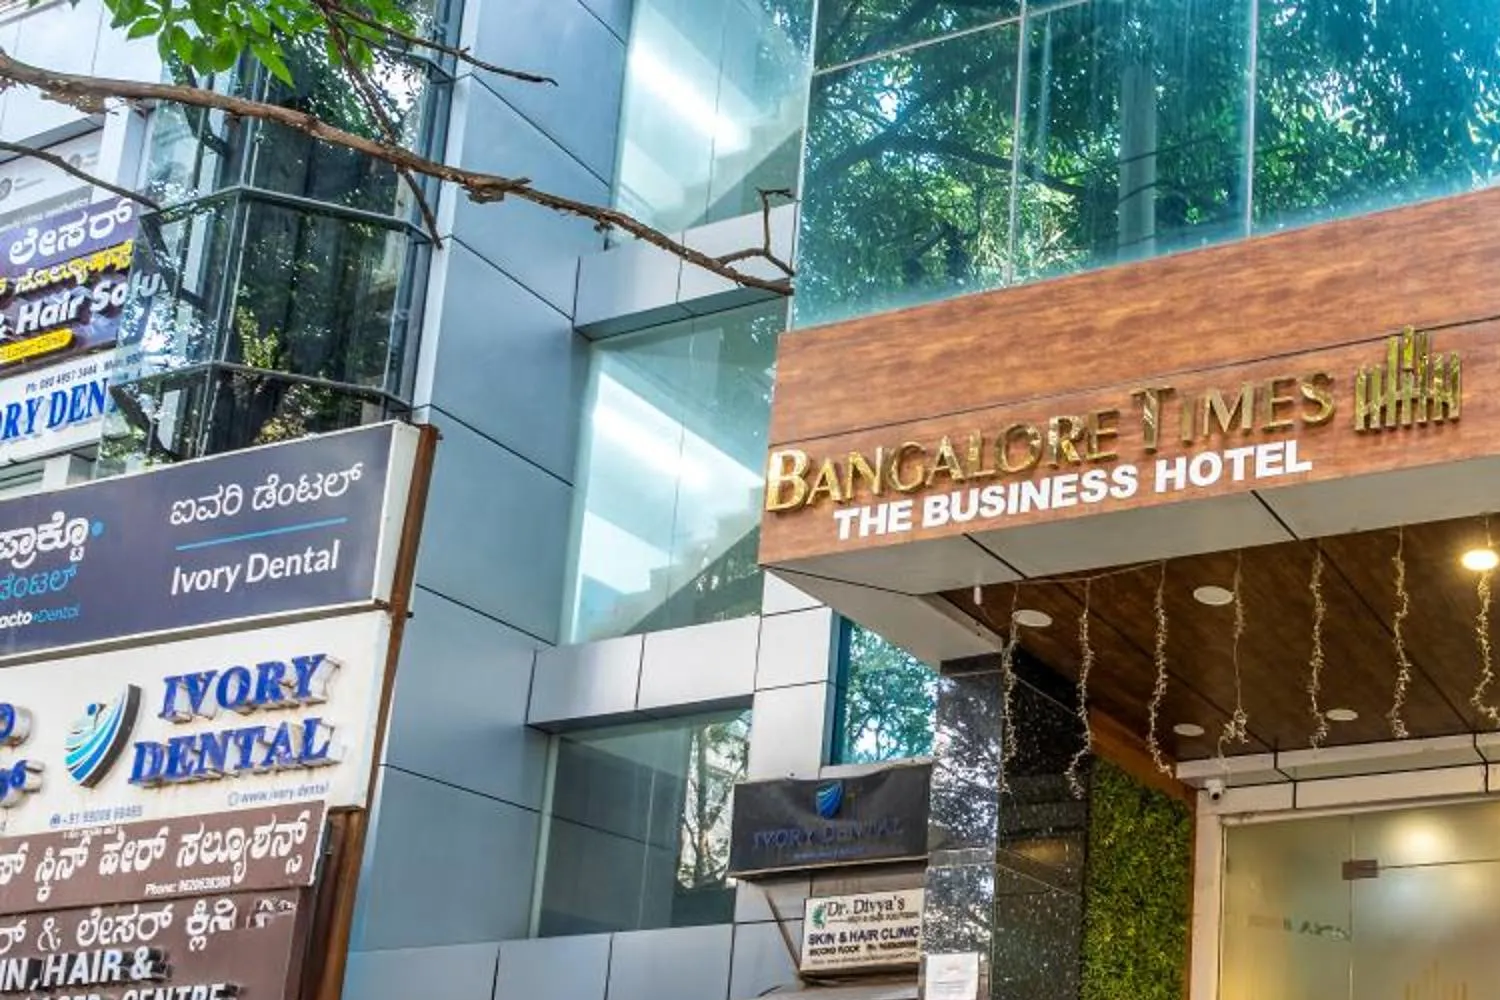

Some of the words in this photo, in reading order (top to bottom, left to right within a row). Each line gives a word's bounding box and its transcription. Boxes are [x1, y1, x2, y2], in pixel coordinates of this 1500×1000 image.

[15, 291, 85, 336] Hair
[0, 395, 44, 441] RY
[765, 409, 1121, 513] BANGALORE
[1130, 372, 1336, 454] TIMES
[170, 483, 244, 527] ಐವರಿ
[833, 499, 914, 541] THE
[921, 464, 1139, 528] BUSINESS
[1154, 439, 1313, 494] HOTEL
[171, 562, 241, 597] Ivory
[246, 539, 341, 584] Dental
[158, 653, 330, 722] IVORY
[128, 717, 335, 786] DENTAL
[853, 895, 906, 915] Divya's
[808, 931, 837, 946] SKIN
[849, 928, 880, 942] HAIR
[880, 924, 921, 939] CLINIC
[43, 946, 124, 987] HAIR
[130, 945, 154, 980] &
